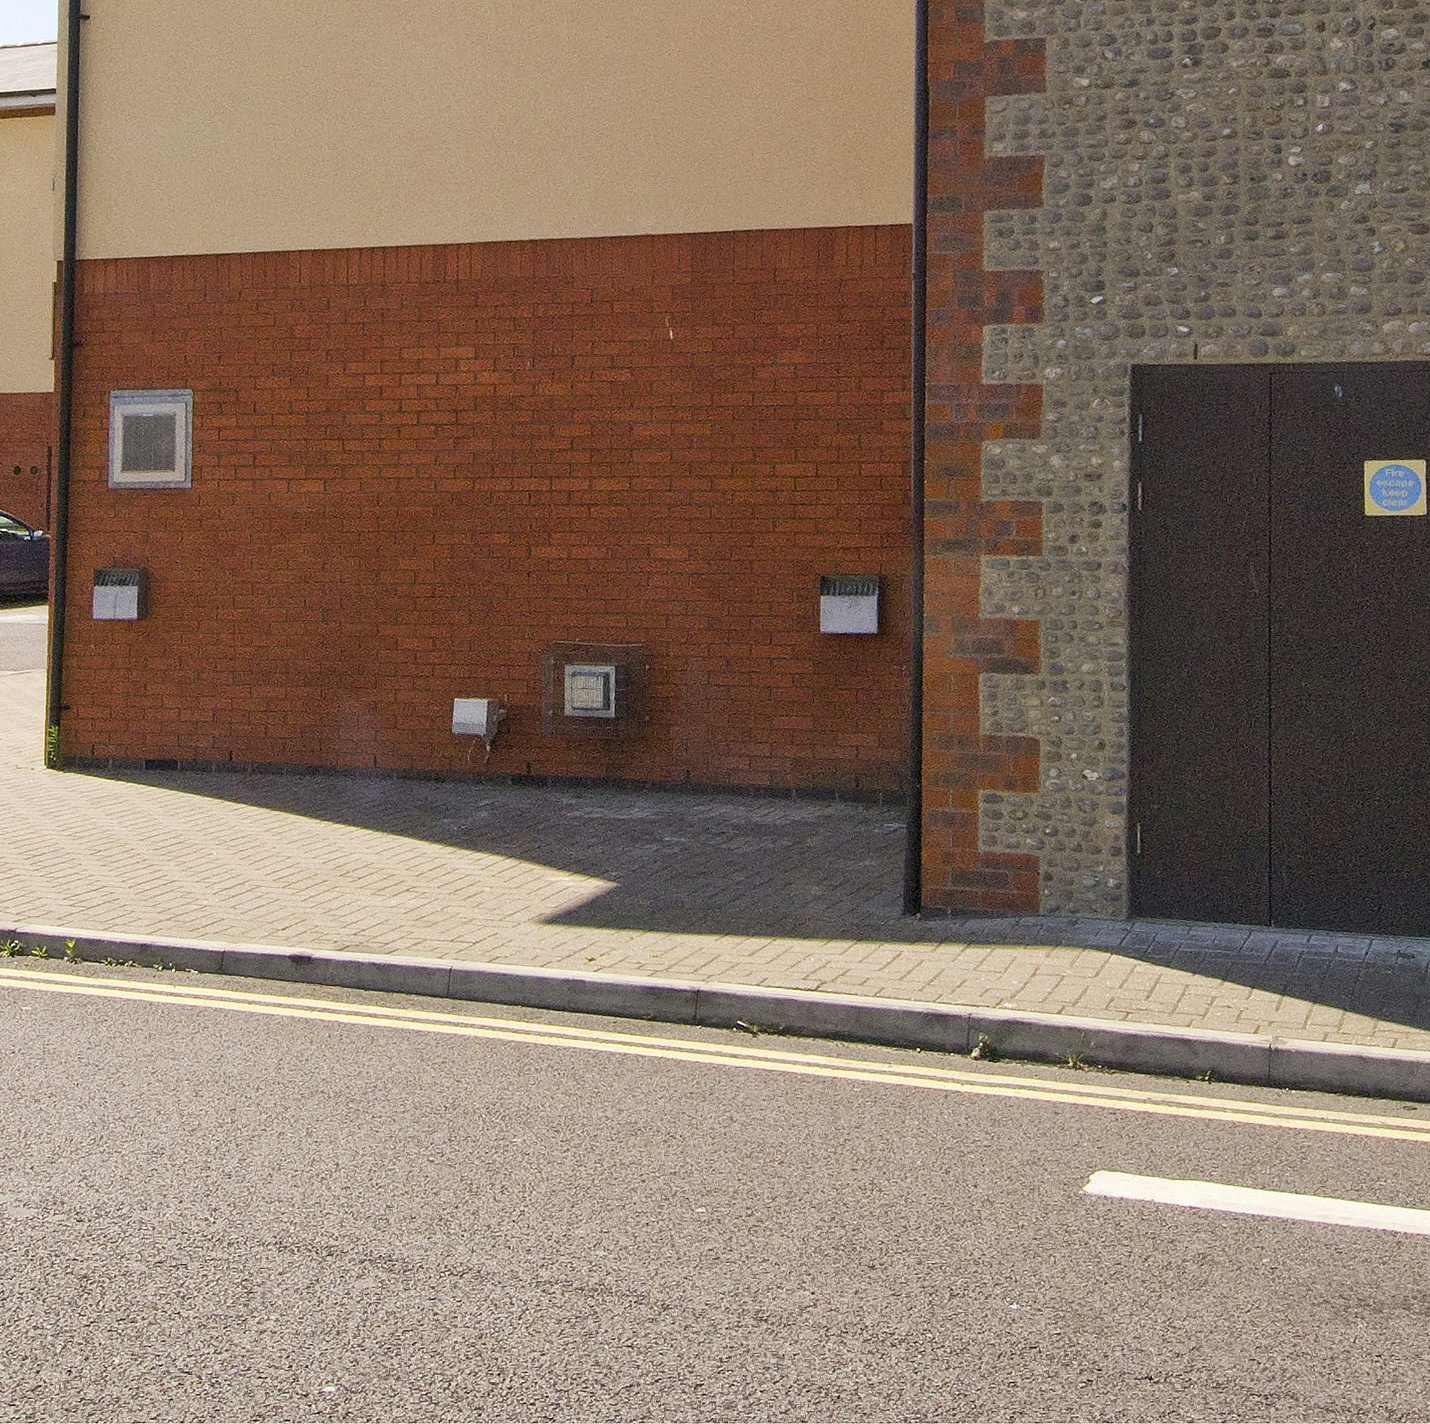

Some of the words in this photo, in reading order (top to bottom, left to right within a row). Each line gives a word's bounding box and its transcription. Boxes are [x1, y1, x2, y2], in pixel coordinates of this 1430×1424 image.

[1385, 468, 1405, 477] Fire
[1382, 488, 1408, 497] keep
[1382, 499, 1408, 507] clear
